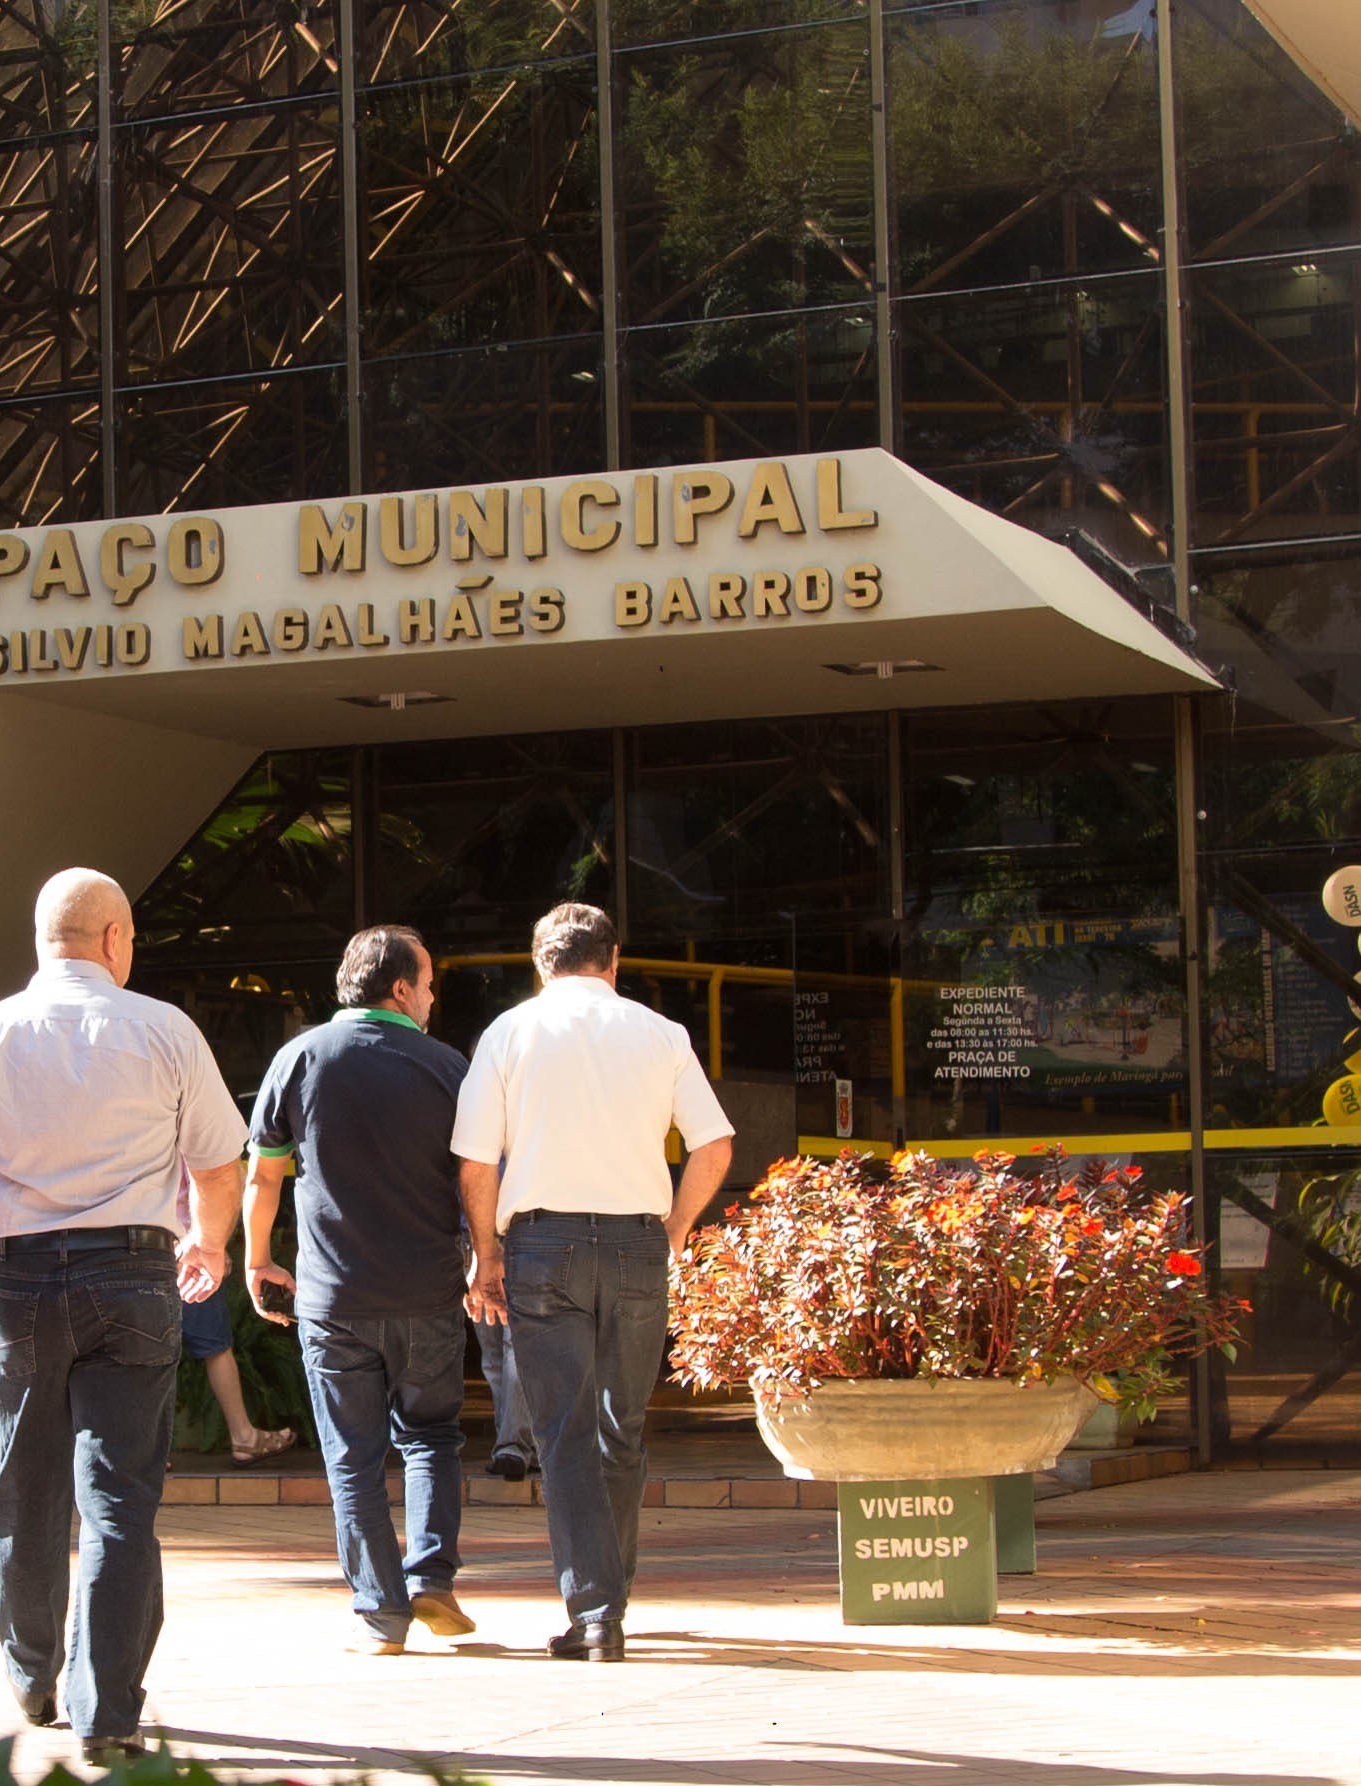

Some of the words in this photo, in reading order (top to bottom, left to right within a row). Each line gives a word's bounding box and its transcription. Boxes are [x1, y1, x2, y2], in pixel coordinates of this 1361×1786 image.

[298, 458, 878, 577] MUNICIPAL
[183, 575, 565, 662] MAGALHÃES
[615, 563, 884, 628] BARROS
[1343, 885, 1361, 918] DASN
[1008, 920, 1065, 948] ATI
[940, 986, 1026, 1000] EXPEDIENTE
[953, 1002, 1013, 1015] NORMAL
[943, 1016, 985, 1027] Segunda
[995, 1015, 1022, 1025] Sexta
[930, 1028, 948, 1037] das
[926, 1040, 933, 1049] e
[934, 1039, 952, 1049] das
[948, 1051, 995, 1065] PRAÇA
[998, 1050, 1016, 1062] DE
[934, 1065, 1031, 1079] ATENDIMENTO
[859, 1496, 954, 1520] VIVEIRO
[855, 1536, 969, 1560] SEMUSP
[872, 1579, 945, 1602] PMM
